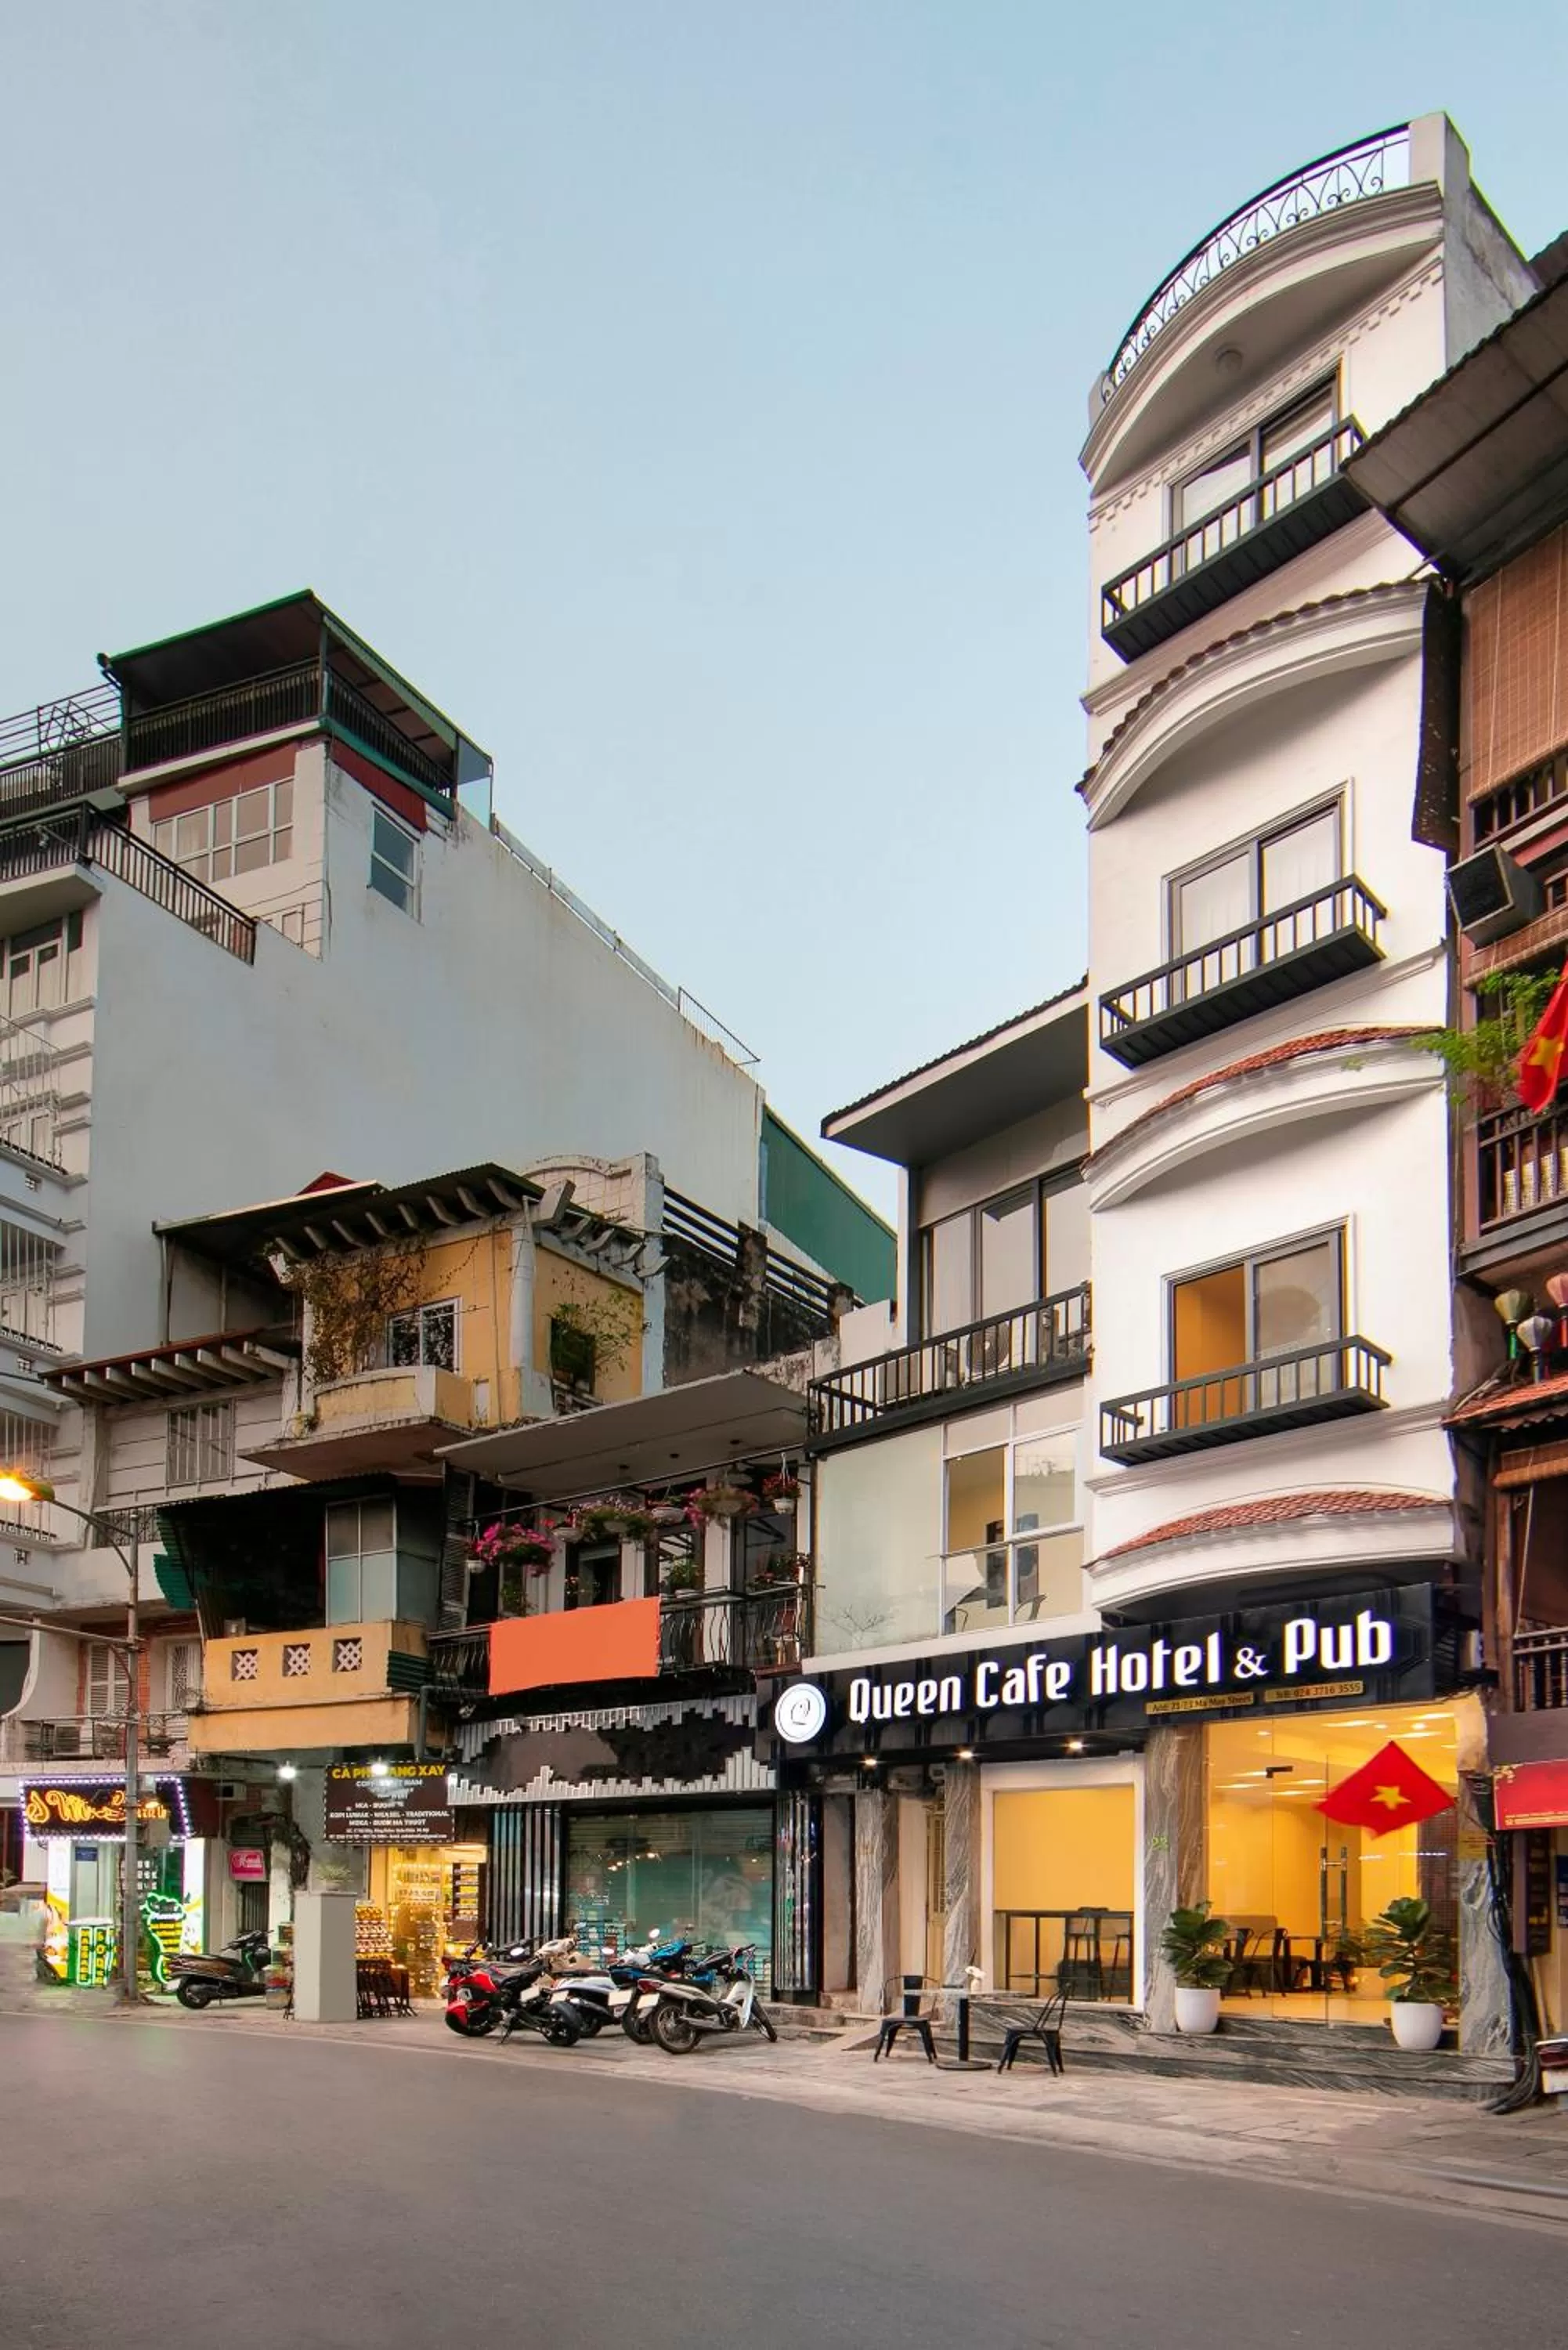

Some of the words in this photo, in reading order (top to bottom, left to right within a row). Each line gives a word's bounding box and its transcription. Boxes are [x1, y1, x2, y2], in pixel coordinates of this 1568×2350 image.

[849, 1679, 962, 1723] Queen
[977, 1654, 1071, 1708] Cafe
[1091, 1631, 1221, 1696] Hotel
[1234, 1647, 1269, 1679] &
[1284, 1609, 1393, 1674] Pub
[418, 1764, 446, 1776] XAY
